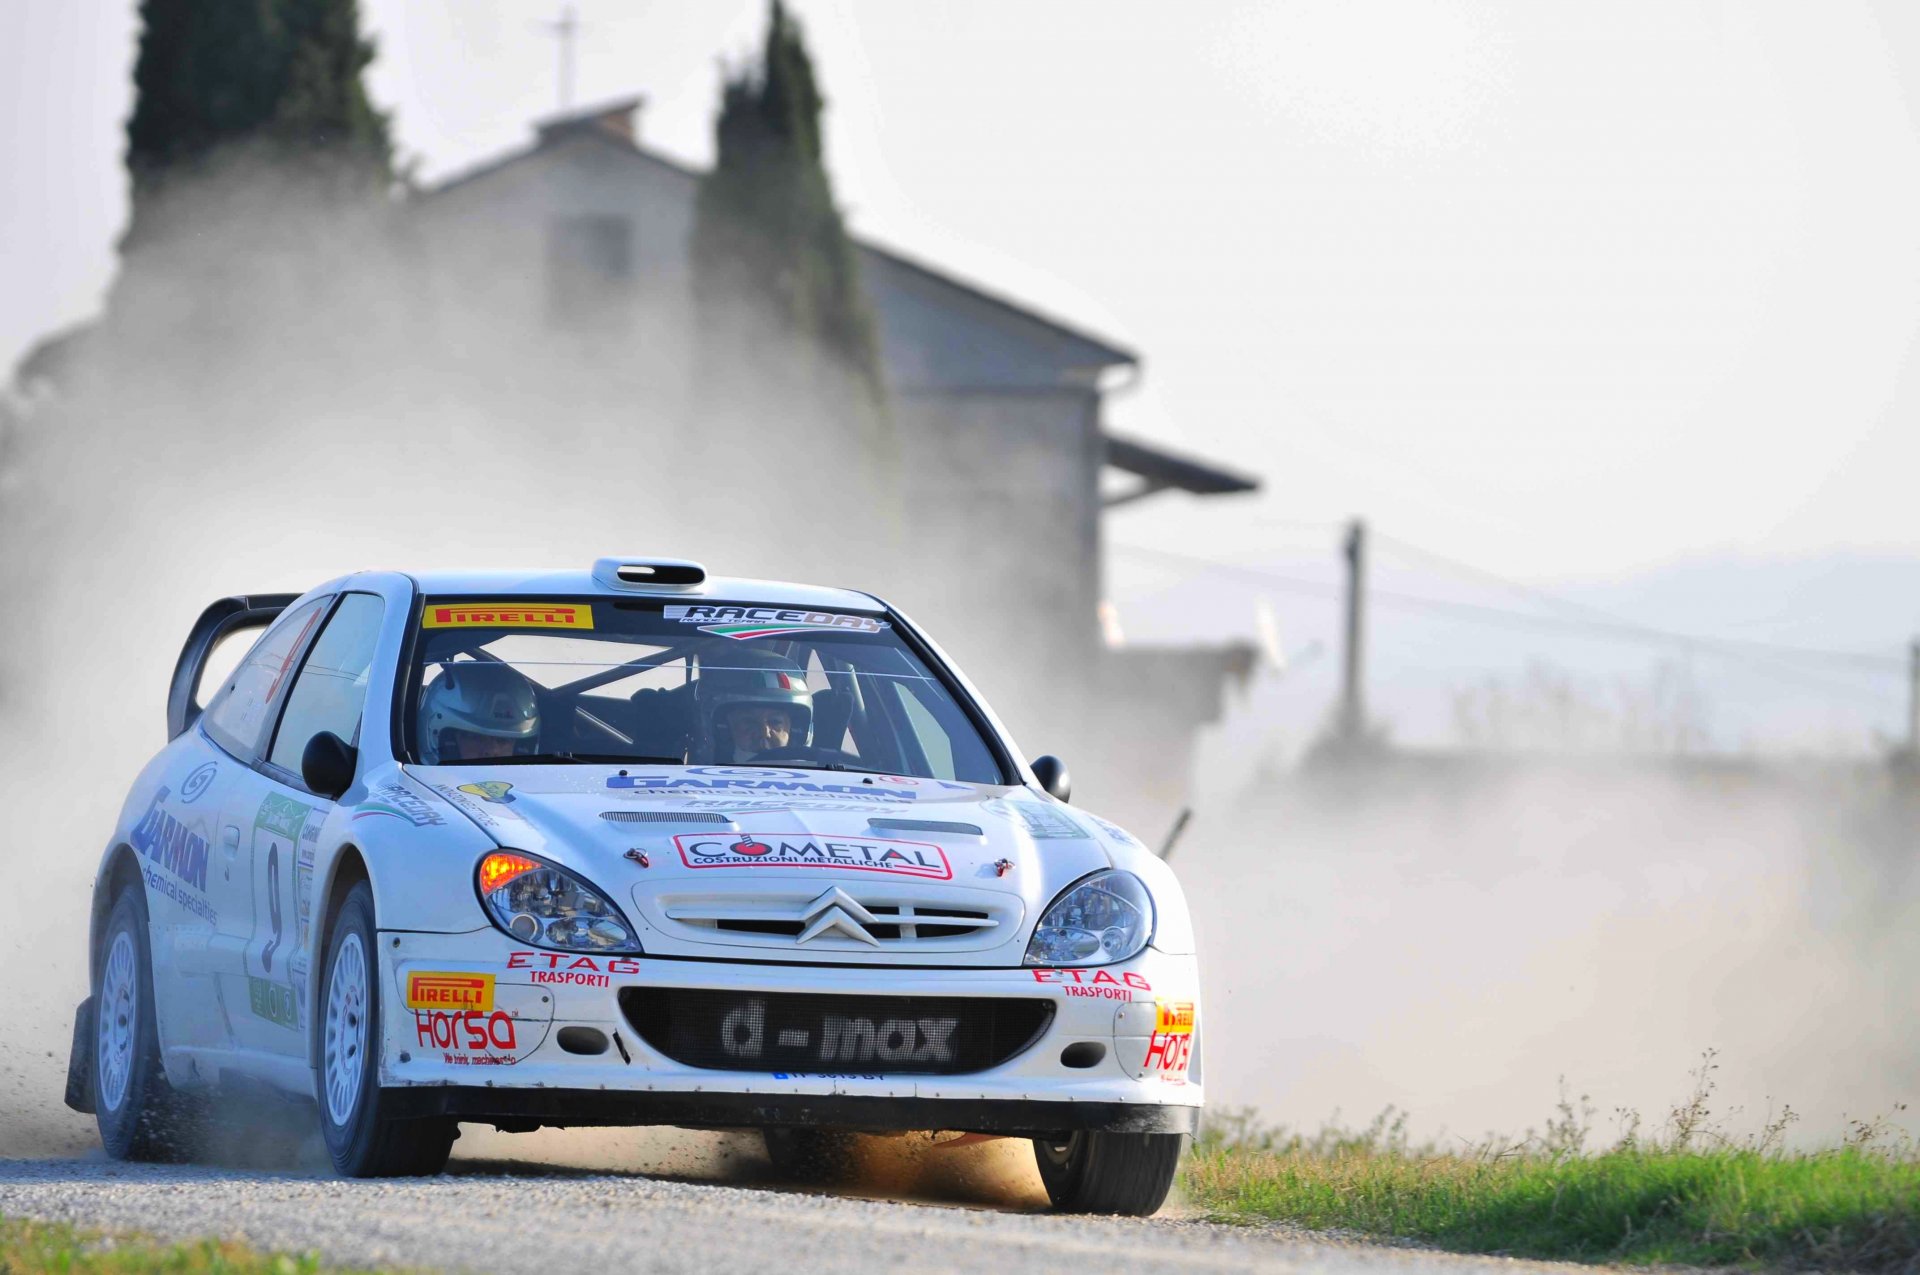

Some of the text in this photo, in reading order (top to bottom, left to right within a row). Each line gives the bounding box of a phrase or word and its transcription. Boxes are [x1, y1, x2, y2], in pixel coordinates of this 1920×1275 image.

[435, 608, 576, 623] PIRELLI
[685, 606, 891, 632] RACEDAY
[606, 776, 916, 799] GARMON
[130, 785, 210, 893] GARMON
[690, 840, 940, 868] COMETAL
[694, 856, 893, 869] COSTRUZIONI METALLICHE
[143, 866, 178, 900] chemical
[261, 841, 283, 974] 9
[507, 952, 640, 975] ETAG
[412, 977, 485, 1004] PIRELLI
[530, 970, 610, 988] TRASPORTI
[1032, 968, 1152, 992] ETAG
[1063, 986, 1132, 1002] TRASPORTI
[415, 1009, 517, 1050] Horsa
